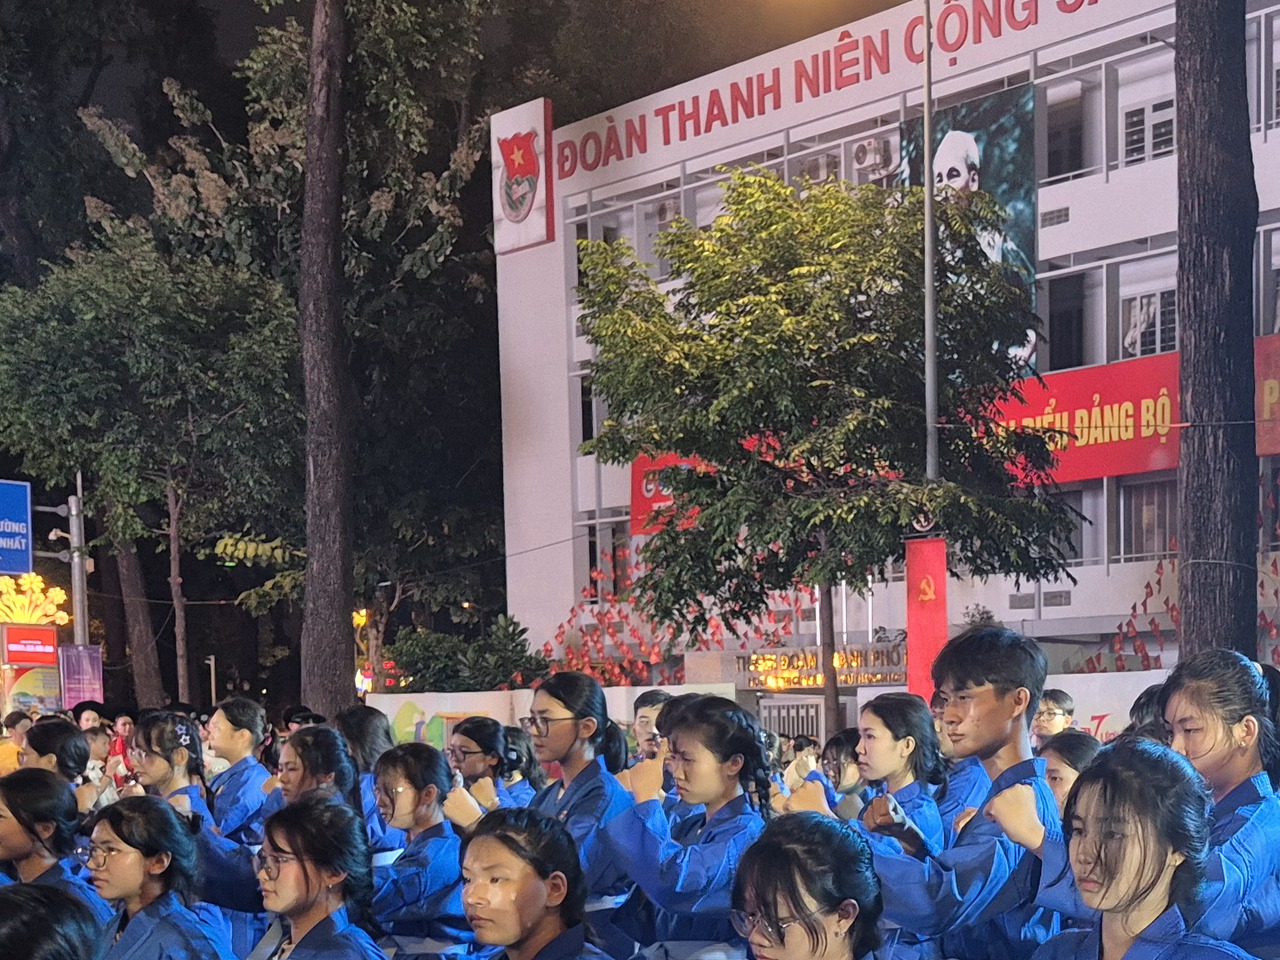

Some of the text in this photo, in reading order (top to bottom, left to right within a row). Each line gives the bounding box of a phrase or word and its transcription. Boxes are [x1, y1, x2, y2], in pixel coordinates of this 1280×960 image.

[557, 114, 648, 180] ĐOÀN
[654, 67, 782, 146] THANH
[794, 30, 890, 104] NIÊN
[1074, 393, 1135, 447] ĐẢNG
[1140, 387, 1171, 443] BỘ
